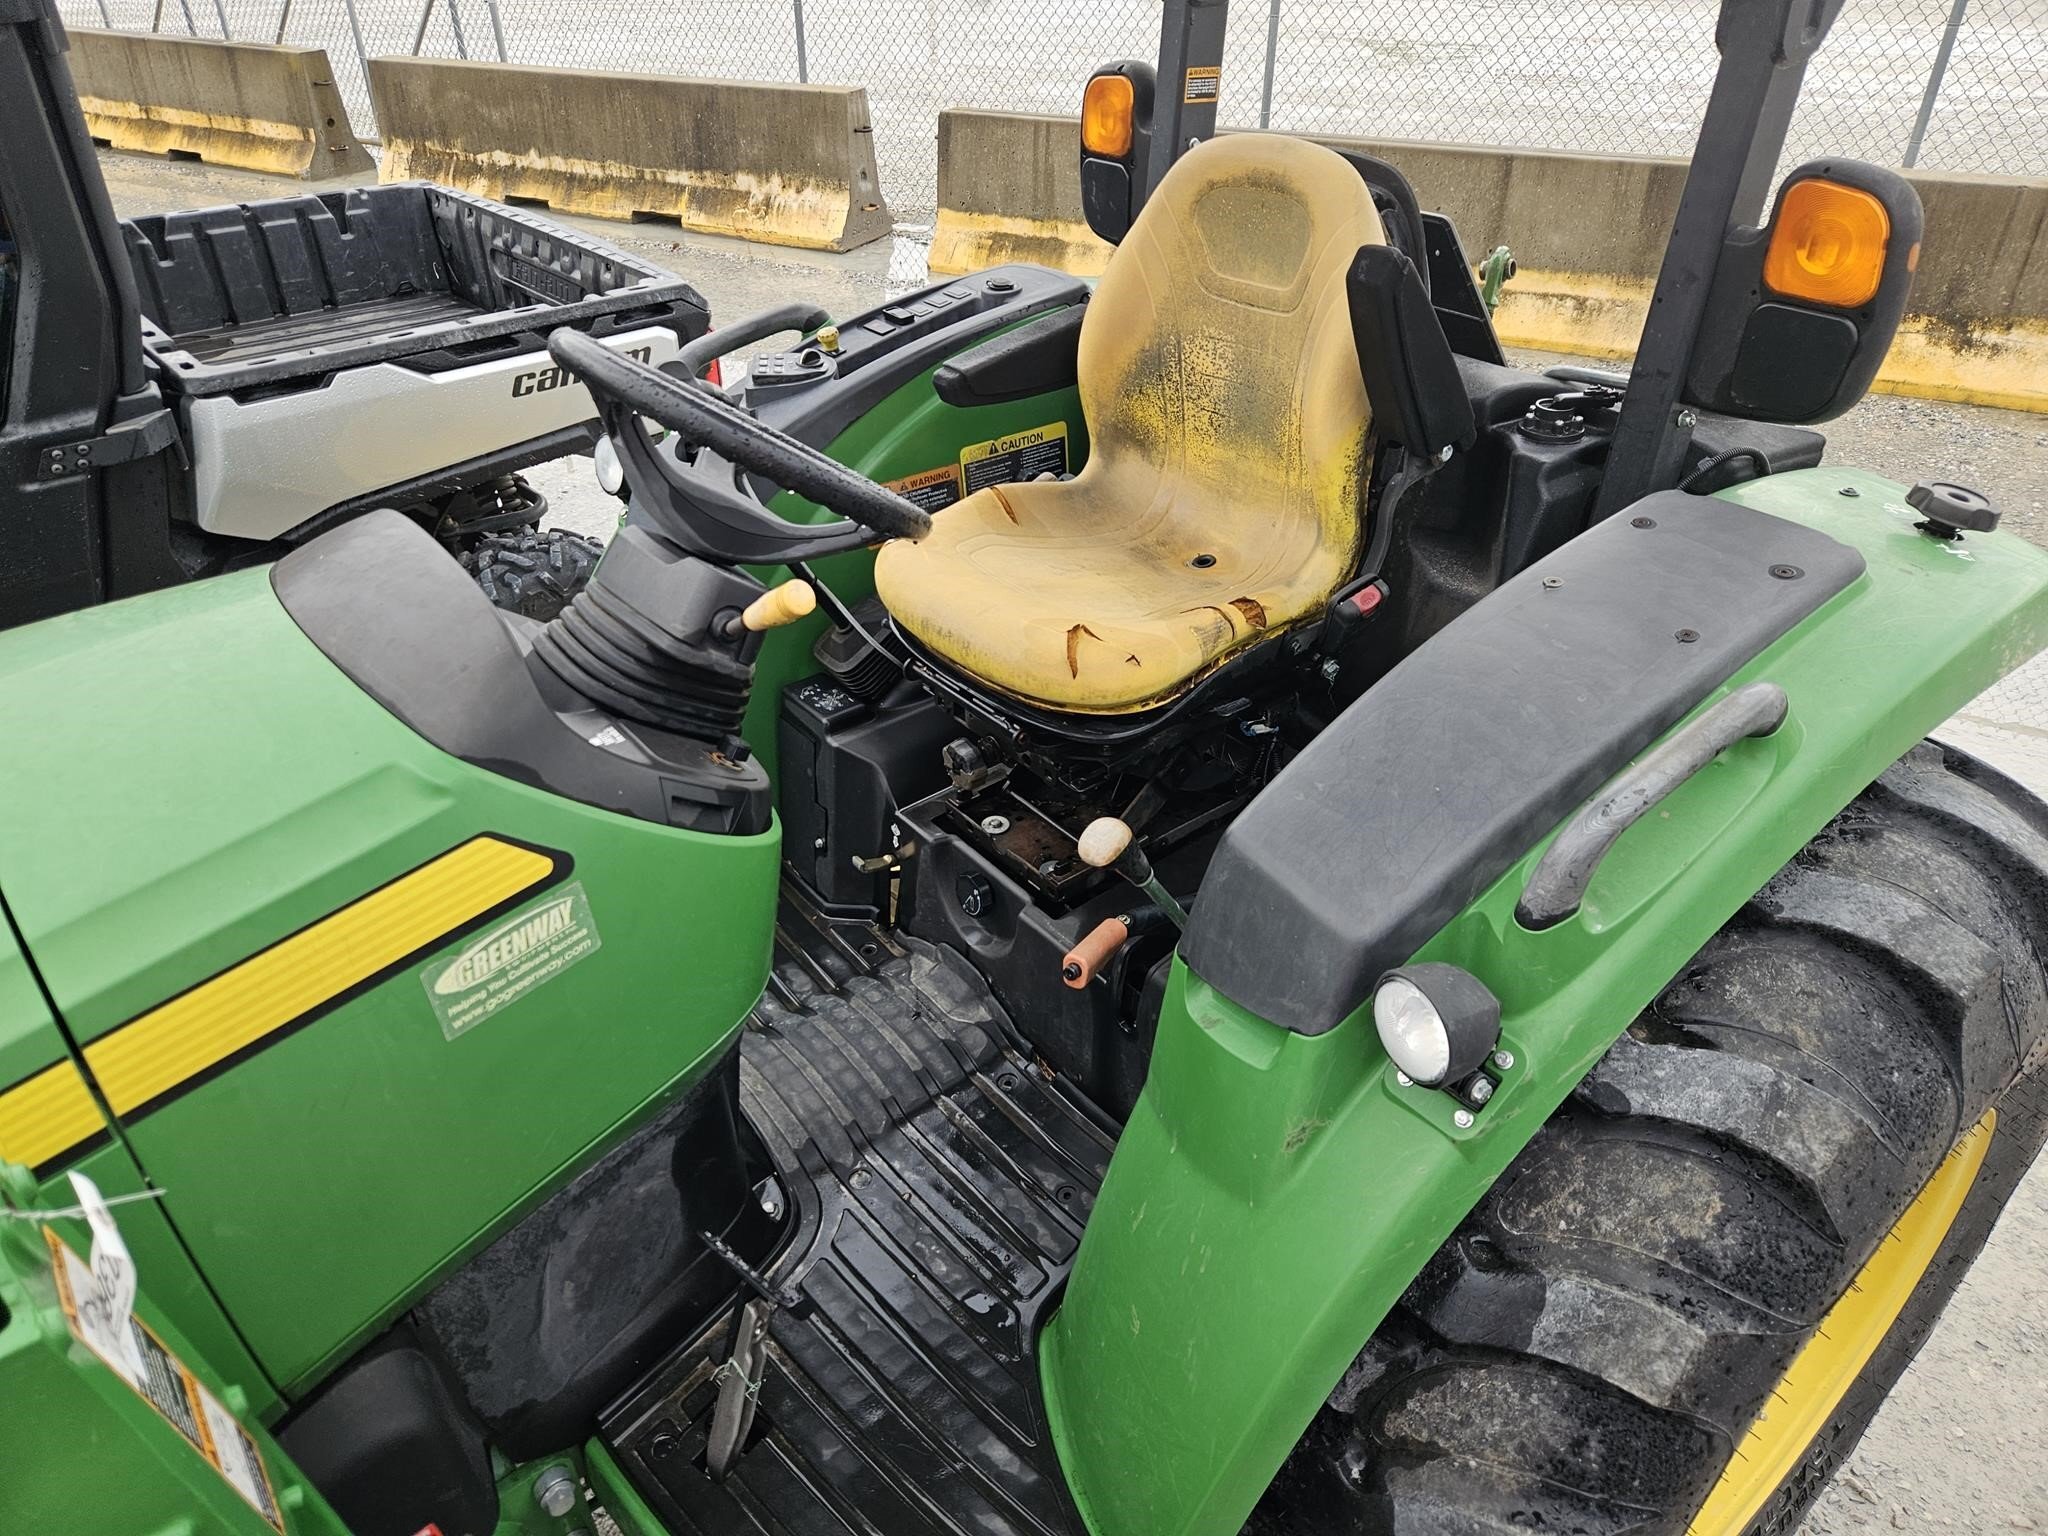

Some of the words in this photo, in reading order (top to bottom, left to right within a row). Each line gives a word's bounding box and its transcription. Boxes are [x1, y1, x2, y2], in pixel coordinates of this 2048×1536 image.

[910, 470, 951, 489] WARNING
[1001, 432, 1044, 452] CAUTION
[447, 989, 488, 1018] Helping
[487, 977, 507, 993] You
[507, 951, 550, 981] Cultivate
[549, 927, 588, 955] Success
[451, 939, 592, 1029] www.gogreenway.com
[459, 898, 573, 987] GREENWAY
